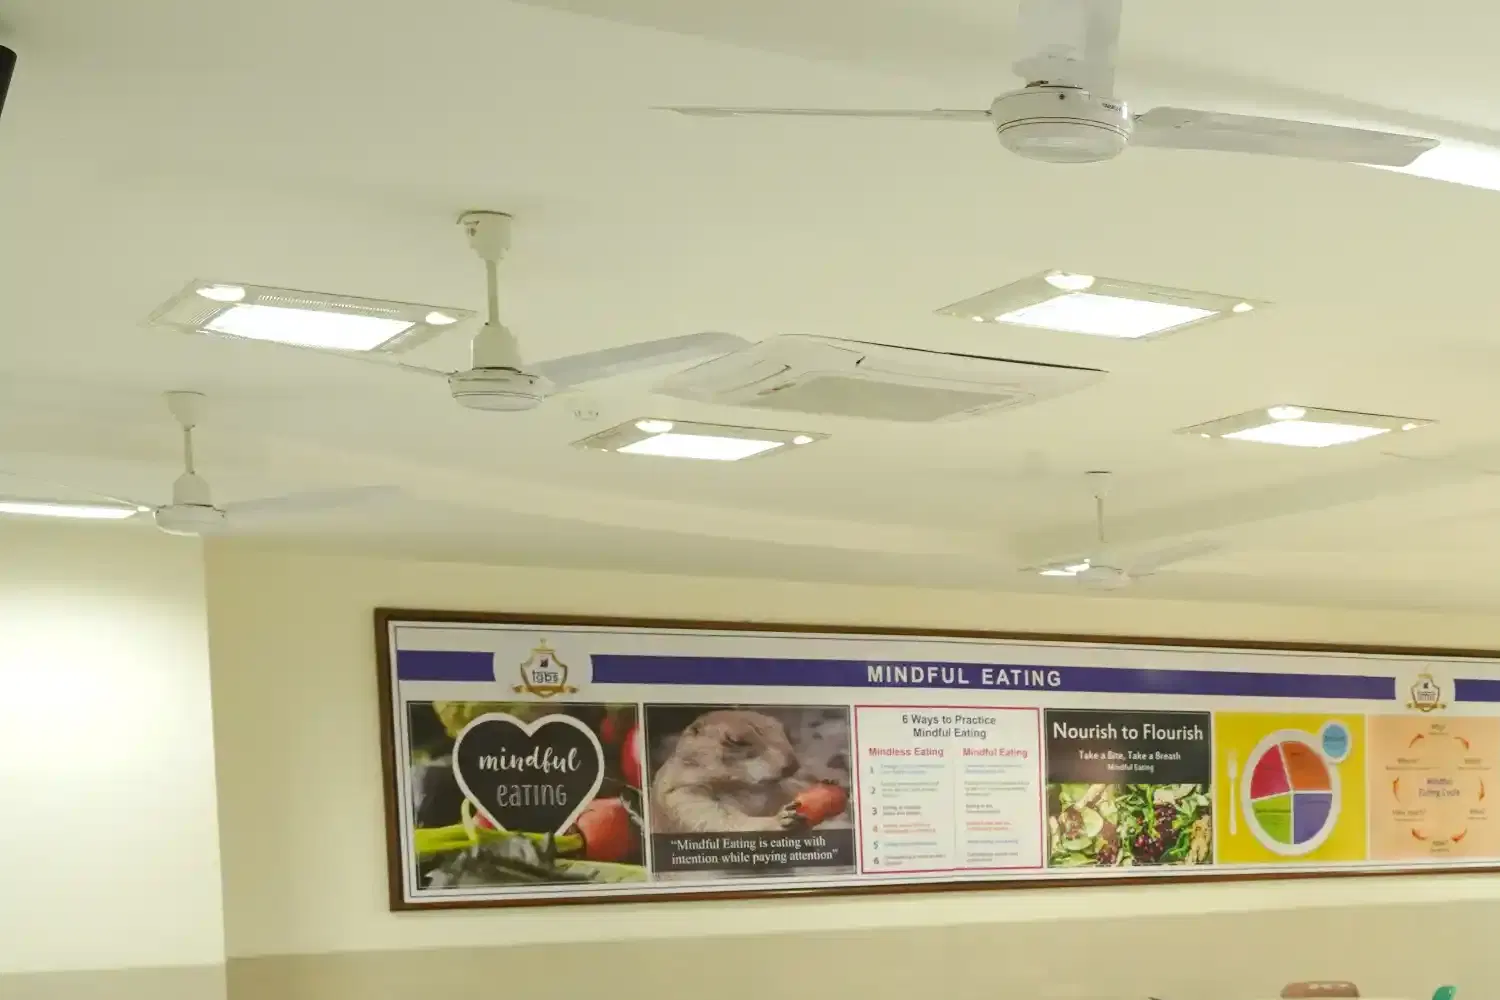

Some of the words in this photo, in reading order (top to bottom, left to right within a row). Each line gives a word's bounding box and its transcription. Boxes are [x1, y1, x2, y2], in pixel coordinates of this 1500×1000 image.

[867, 665, 969, 685] MINDFUL
[982, 668, 1062, 687] EATING
[902, 714, 909, 724] 6
[911, 714, 939, 726] Ways
[942, 715, 951, 725] to
[955, 715, 996, 725] Practice
[913, 728, 951, 737] Mindful
[954, 728, 987, 739] Eating
[1053, 722, 1117, 740] Nourish
[1122, 725, 1138, 740] to
[1142, 723, 1204, 740] Flourish
[868, 747, 912, 757] Mindless
[914, 747, 944, 758] Eating
[962, 747, 997, 757] Mindful
[999, 747, 1028, 759] Eating
[1079, 750, 1098, 760] Take
[1128, 751, 1147, 760] Take
[1155, 751, 1181, 760] Breath
[478, 745, 582, 774] mindful
[671, 839, 720, 850] “Mindful
[723, 839, 756, 850] Eating
[759, 838, 768, 848] is
[770, 837, 801, 849] eating
[804, 836, 826, 846] with
[672, 854, 718, 864] intention
[721, 852, 749, 863] while
[753, 851, 787, 864] paying
[789, 848, 839, 861] attention”
